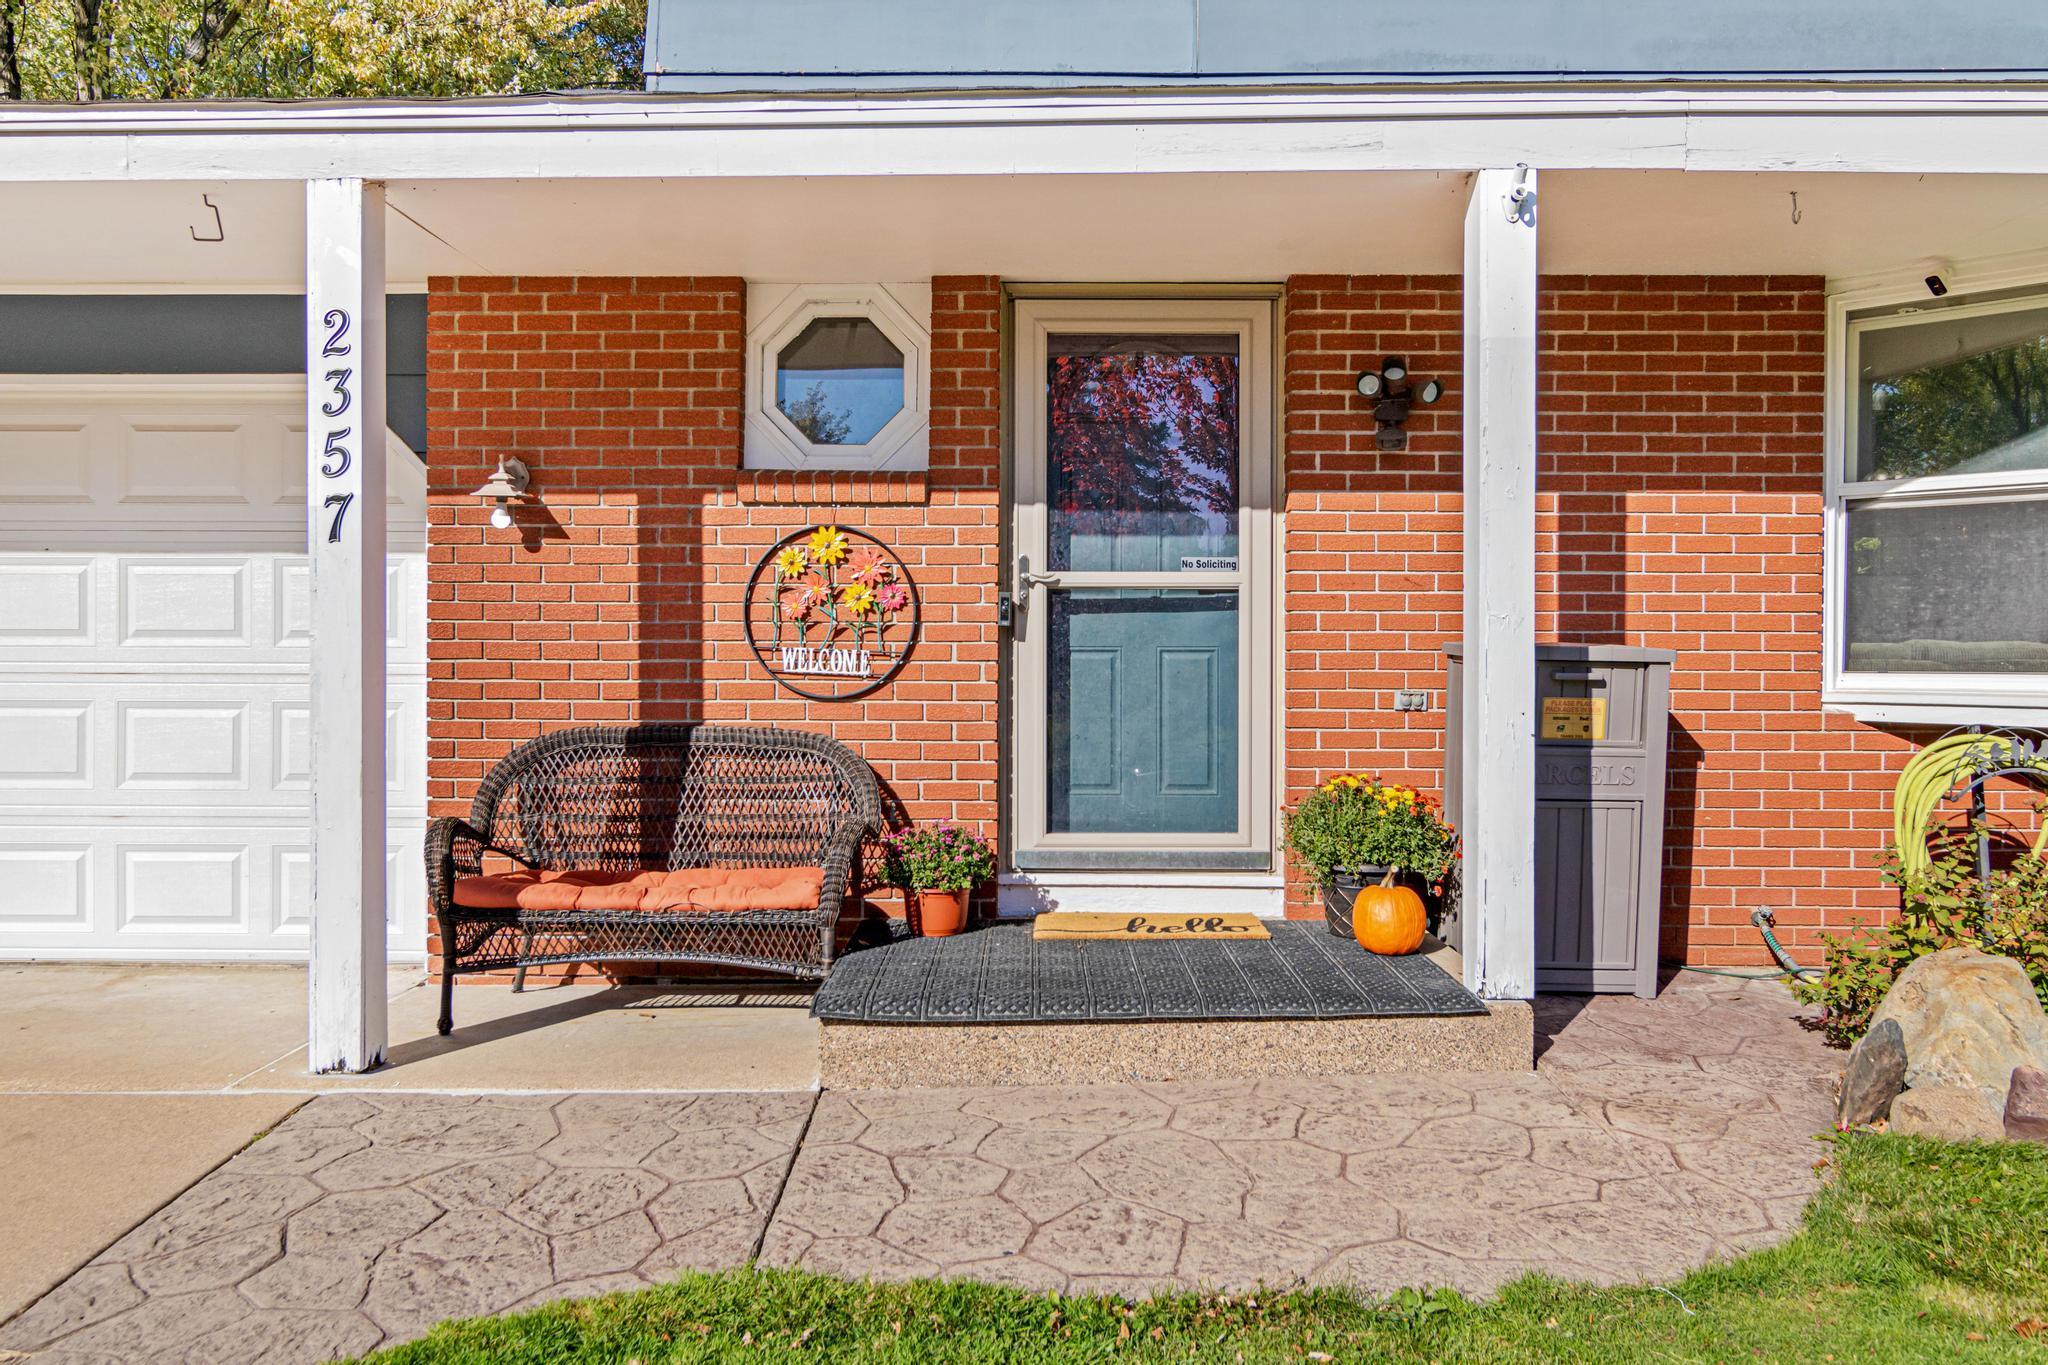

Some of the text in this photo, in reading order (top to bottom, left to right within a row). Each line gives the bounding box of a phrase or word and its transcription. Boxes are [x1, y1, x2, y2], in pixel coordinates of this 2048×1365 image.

[321, 308, 354, 543] 2357
[1182, 559, 1237, 571] No Soliciting
[782, 647, 871, 675] WELCOME
[1124, 917, 1260, 934] hello
